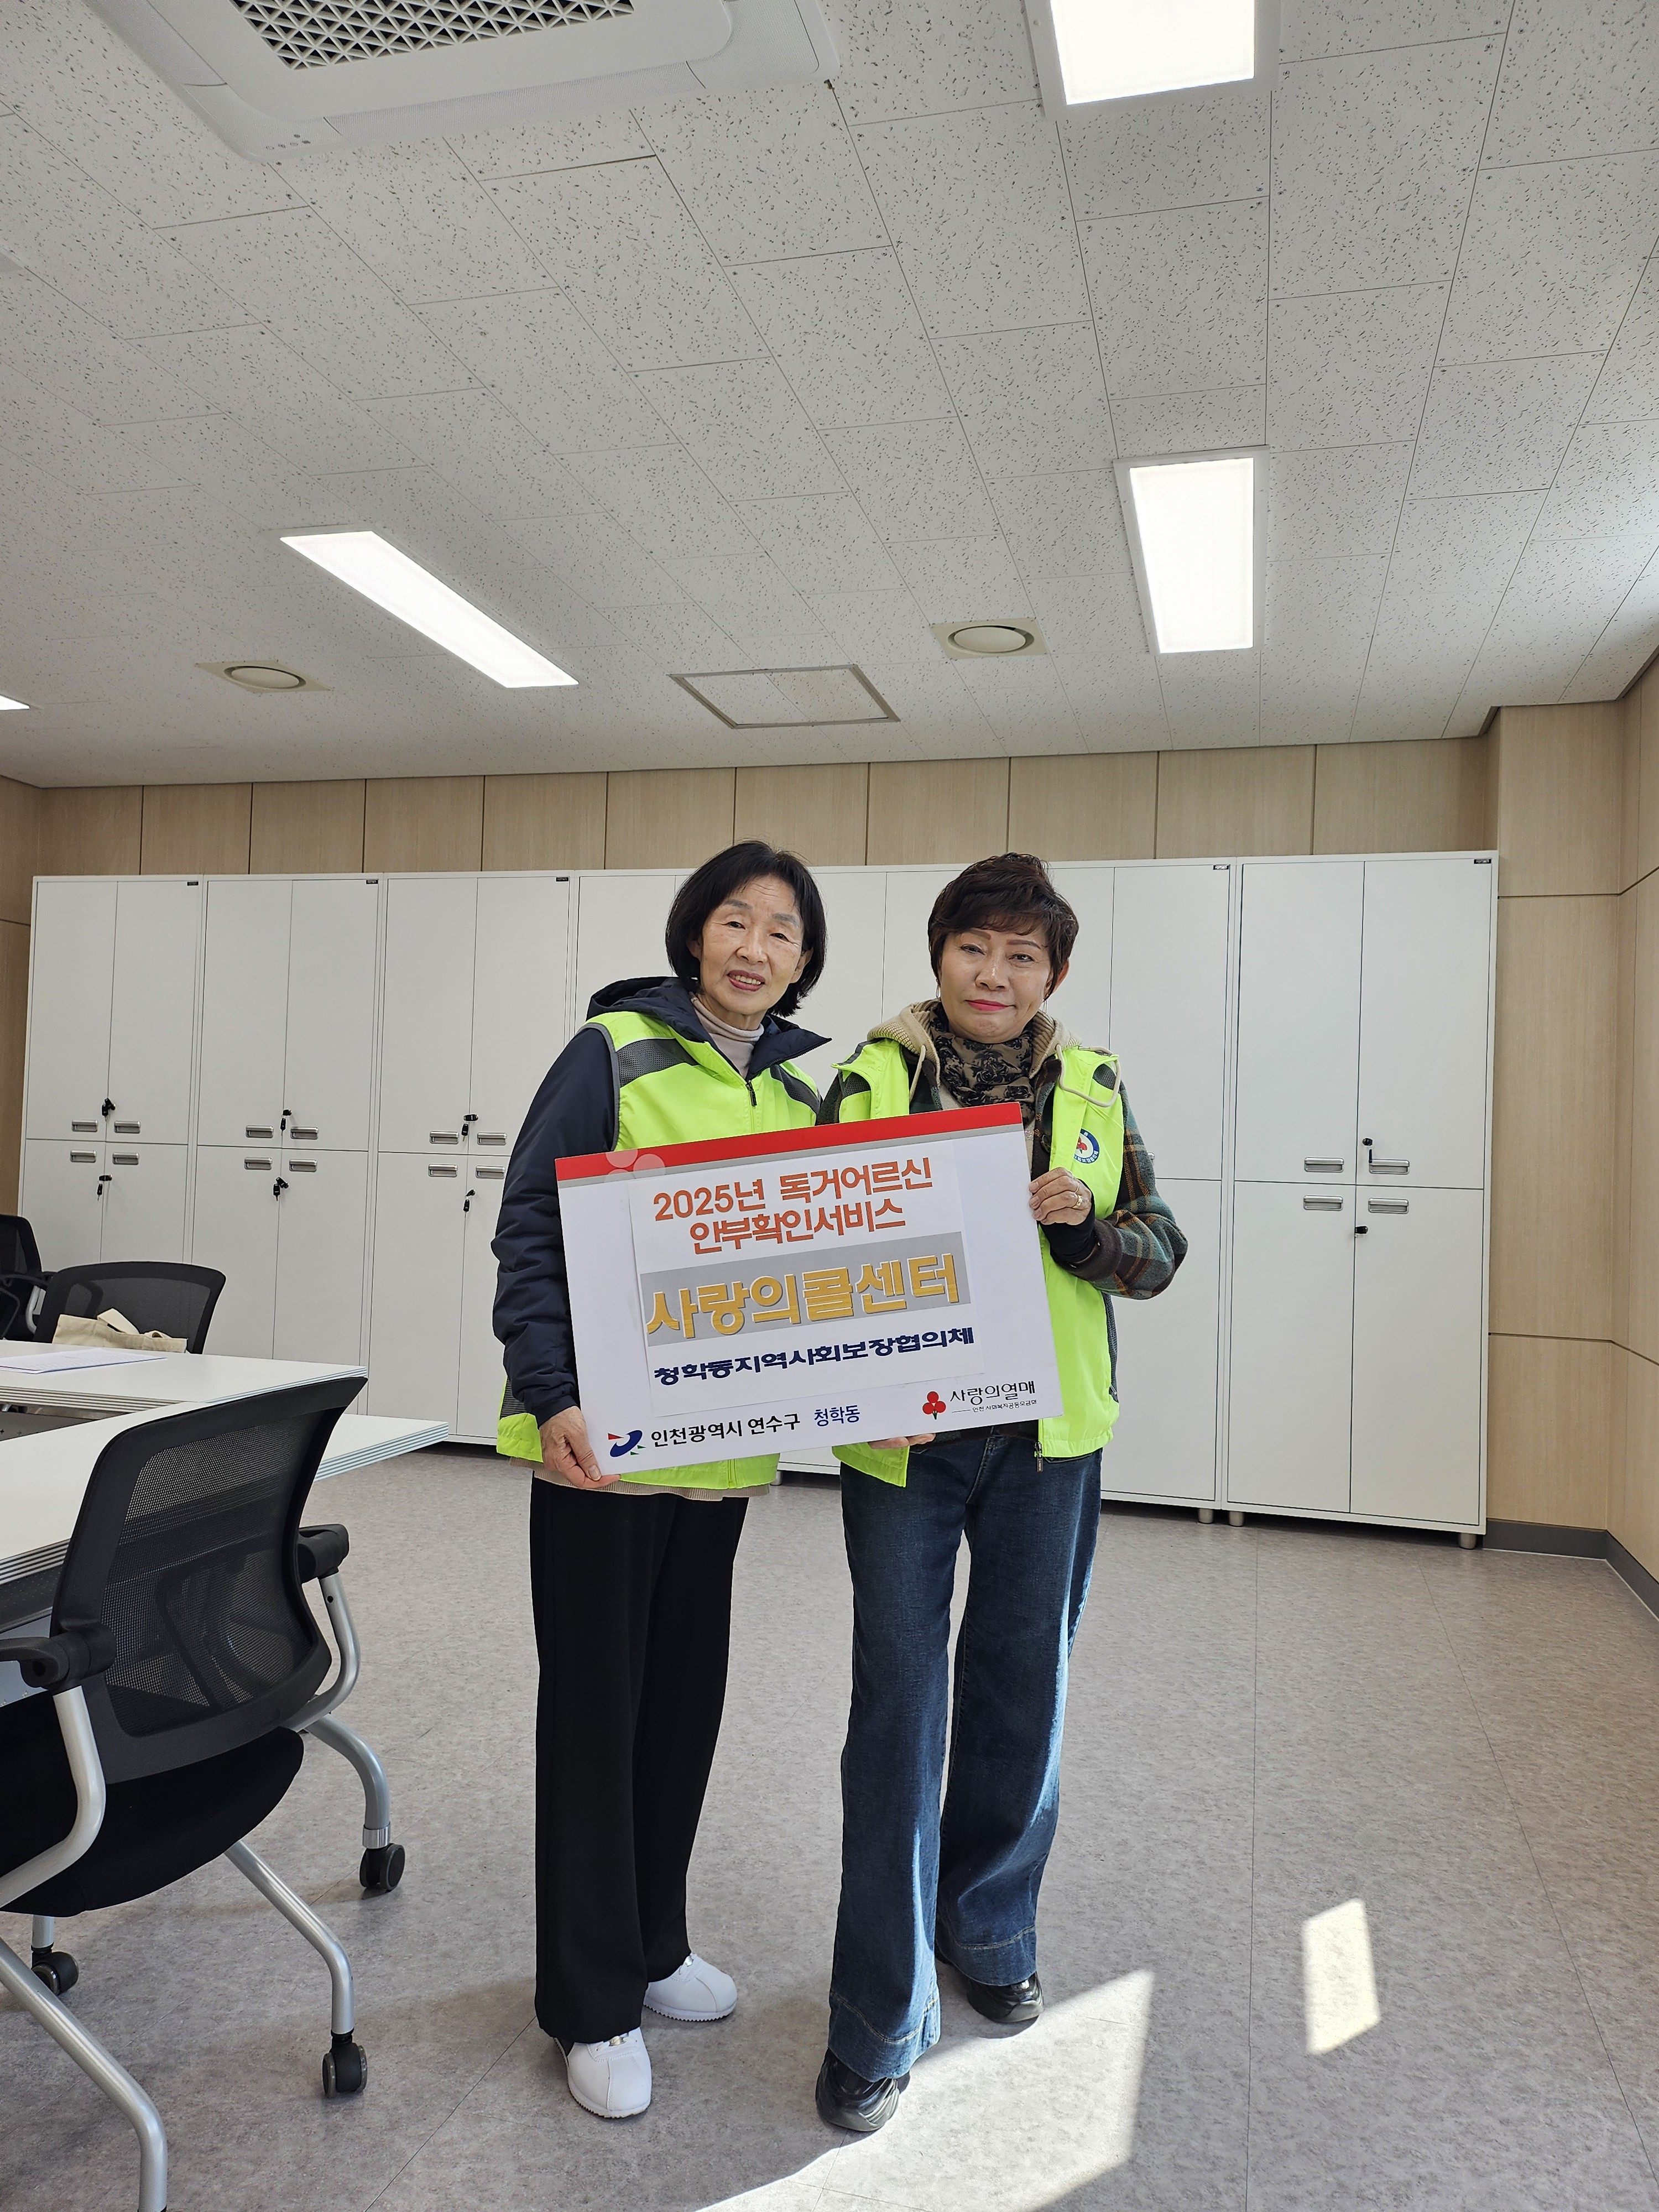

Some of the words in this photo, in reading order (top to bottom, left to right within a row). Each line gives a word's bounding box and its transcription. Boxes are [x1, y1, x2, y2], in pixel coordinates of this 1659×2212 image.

[654, 1179, 765, 1220] 2025년
[780, 1158, 933, 1202] 독거어르신
[690, 1199, 906, 1254] 안부확인서비스
[646, 1253, 959, 1338] 사랑의콜센터
[654, 1327, 974, 1385] 청학동지역사회보장협의체
[950, 1381, 1035, 1405] 사랑의열매
[651, 1421, 742, 1447] 인천광역시
[748, 1413, 801, 1435] 연수구
[814, 1405, 860, 1426] 청학동
